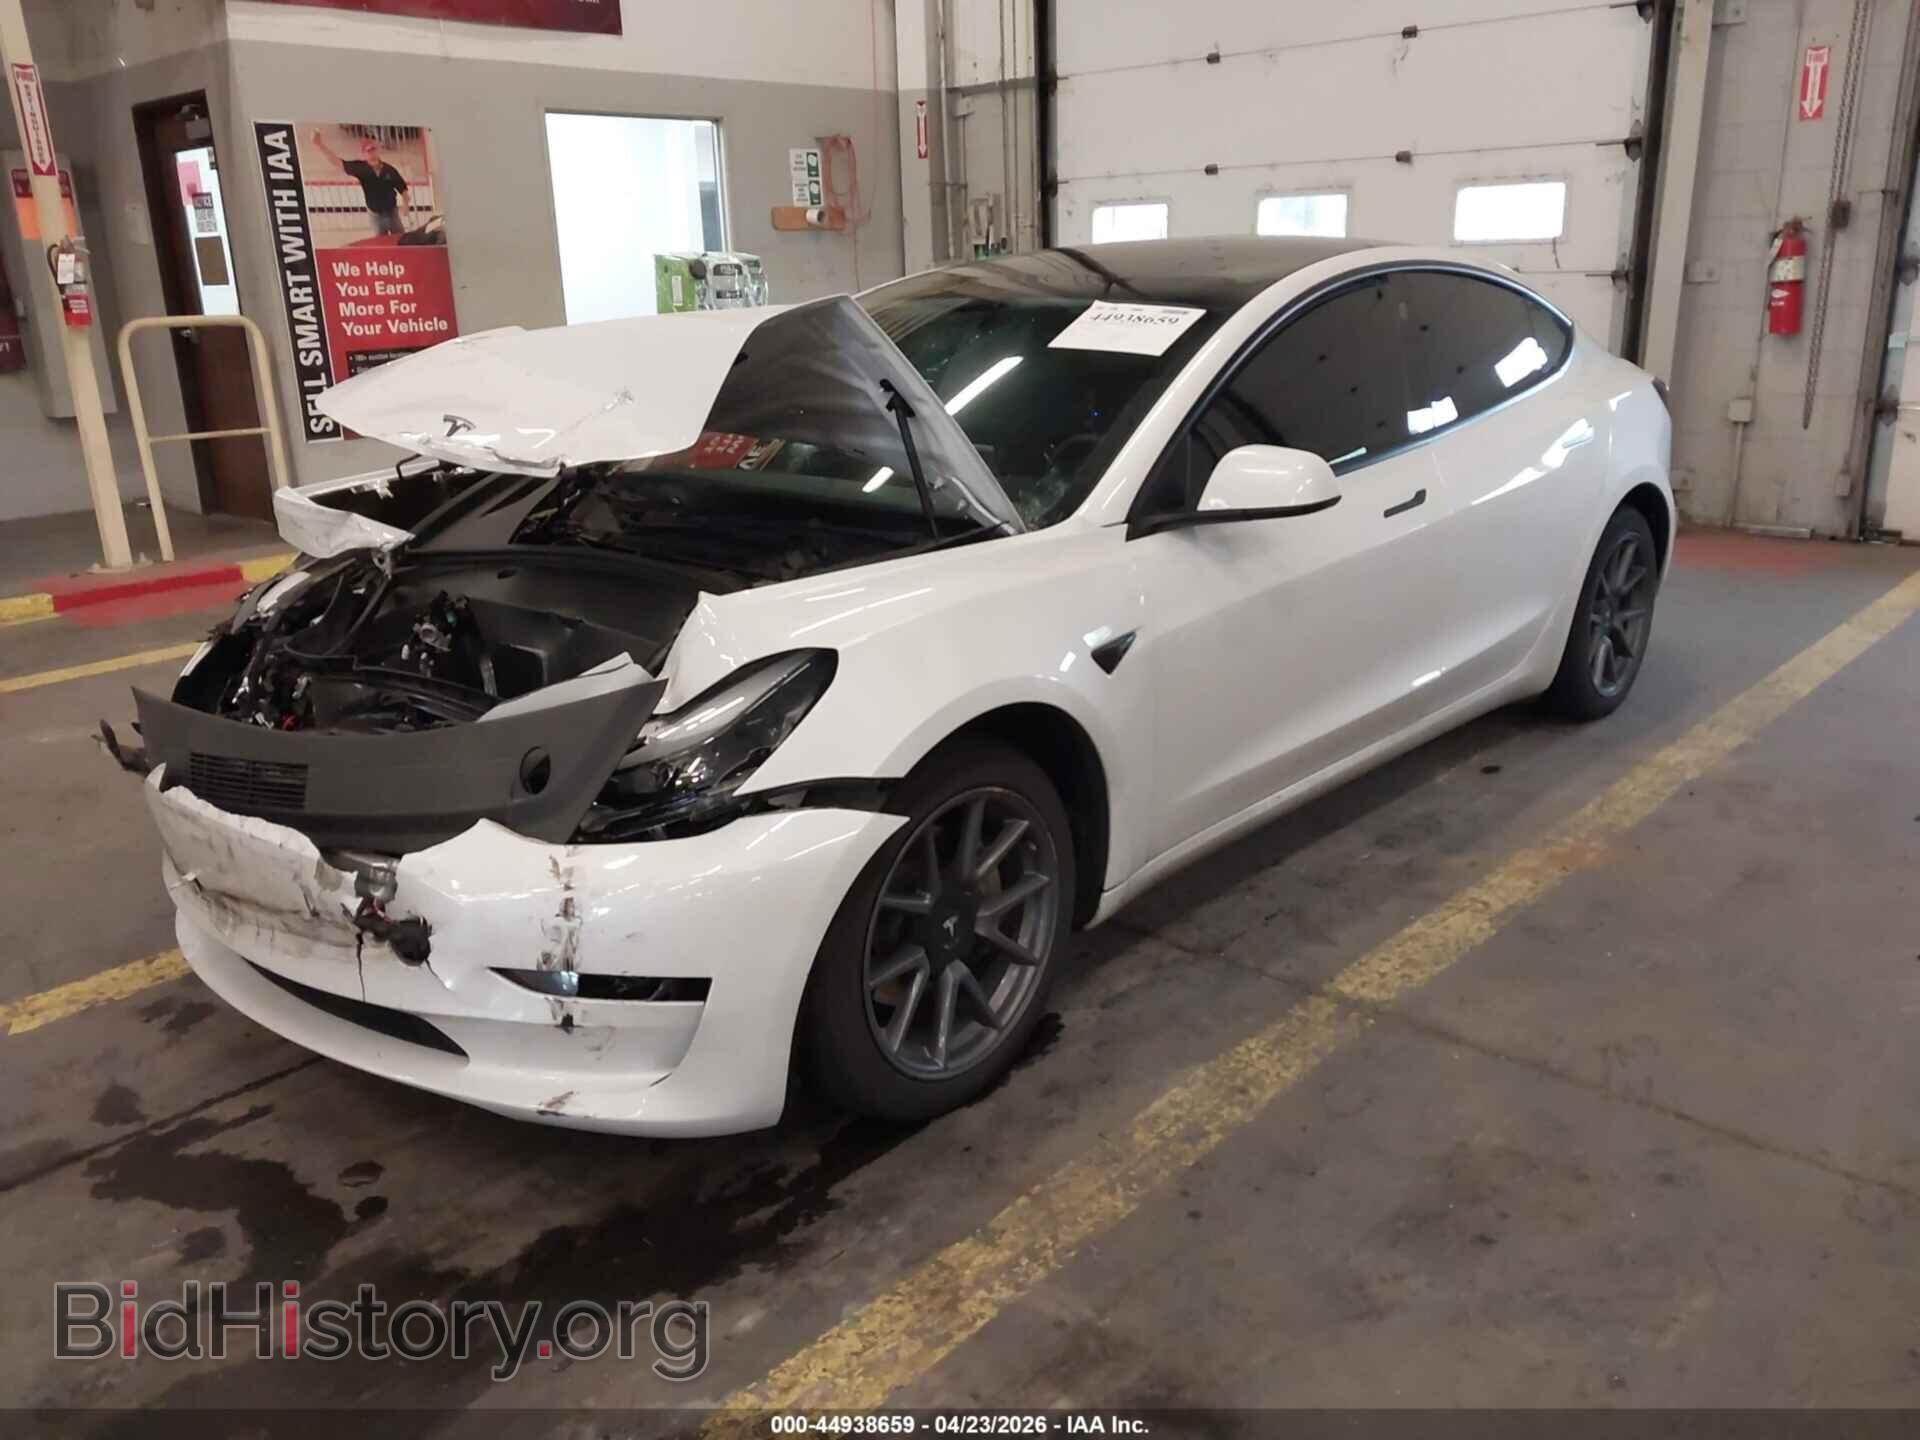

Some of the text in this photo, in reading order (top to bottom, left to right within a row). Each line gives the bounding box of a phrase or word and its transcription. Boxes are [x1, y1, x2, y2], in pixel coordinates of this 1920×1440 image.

[264, 130, 295, 180] IAA
[272, 189, 307, 264] WITH
[332, 260, 405, 279] We Help
[336, 281, 414, 297] You Earn
[286, 270, 324, 366] SMART
[339, 300, 417, 317] More For
[342, 316, 448, 336] Your Vehicle
